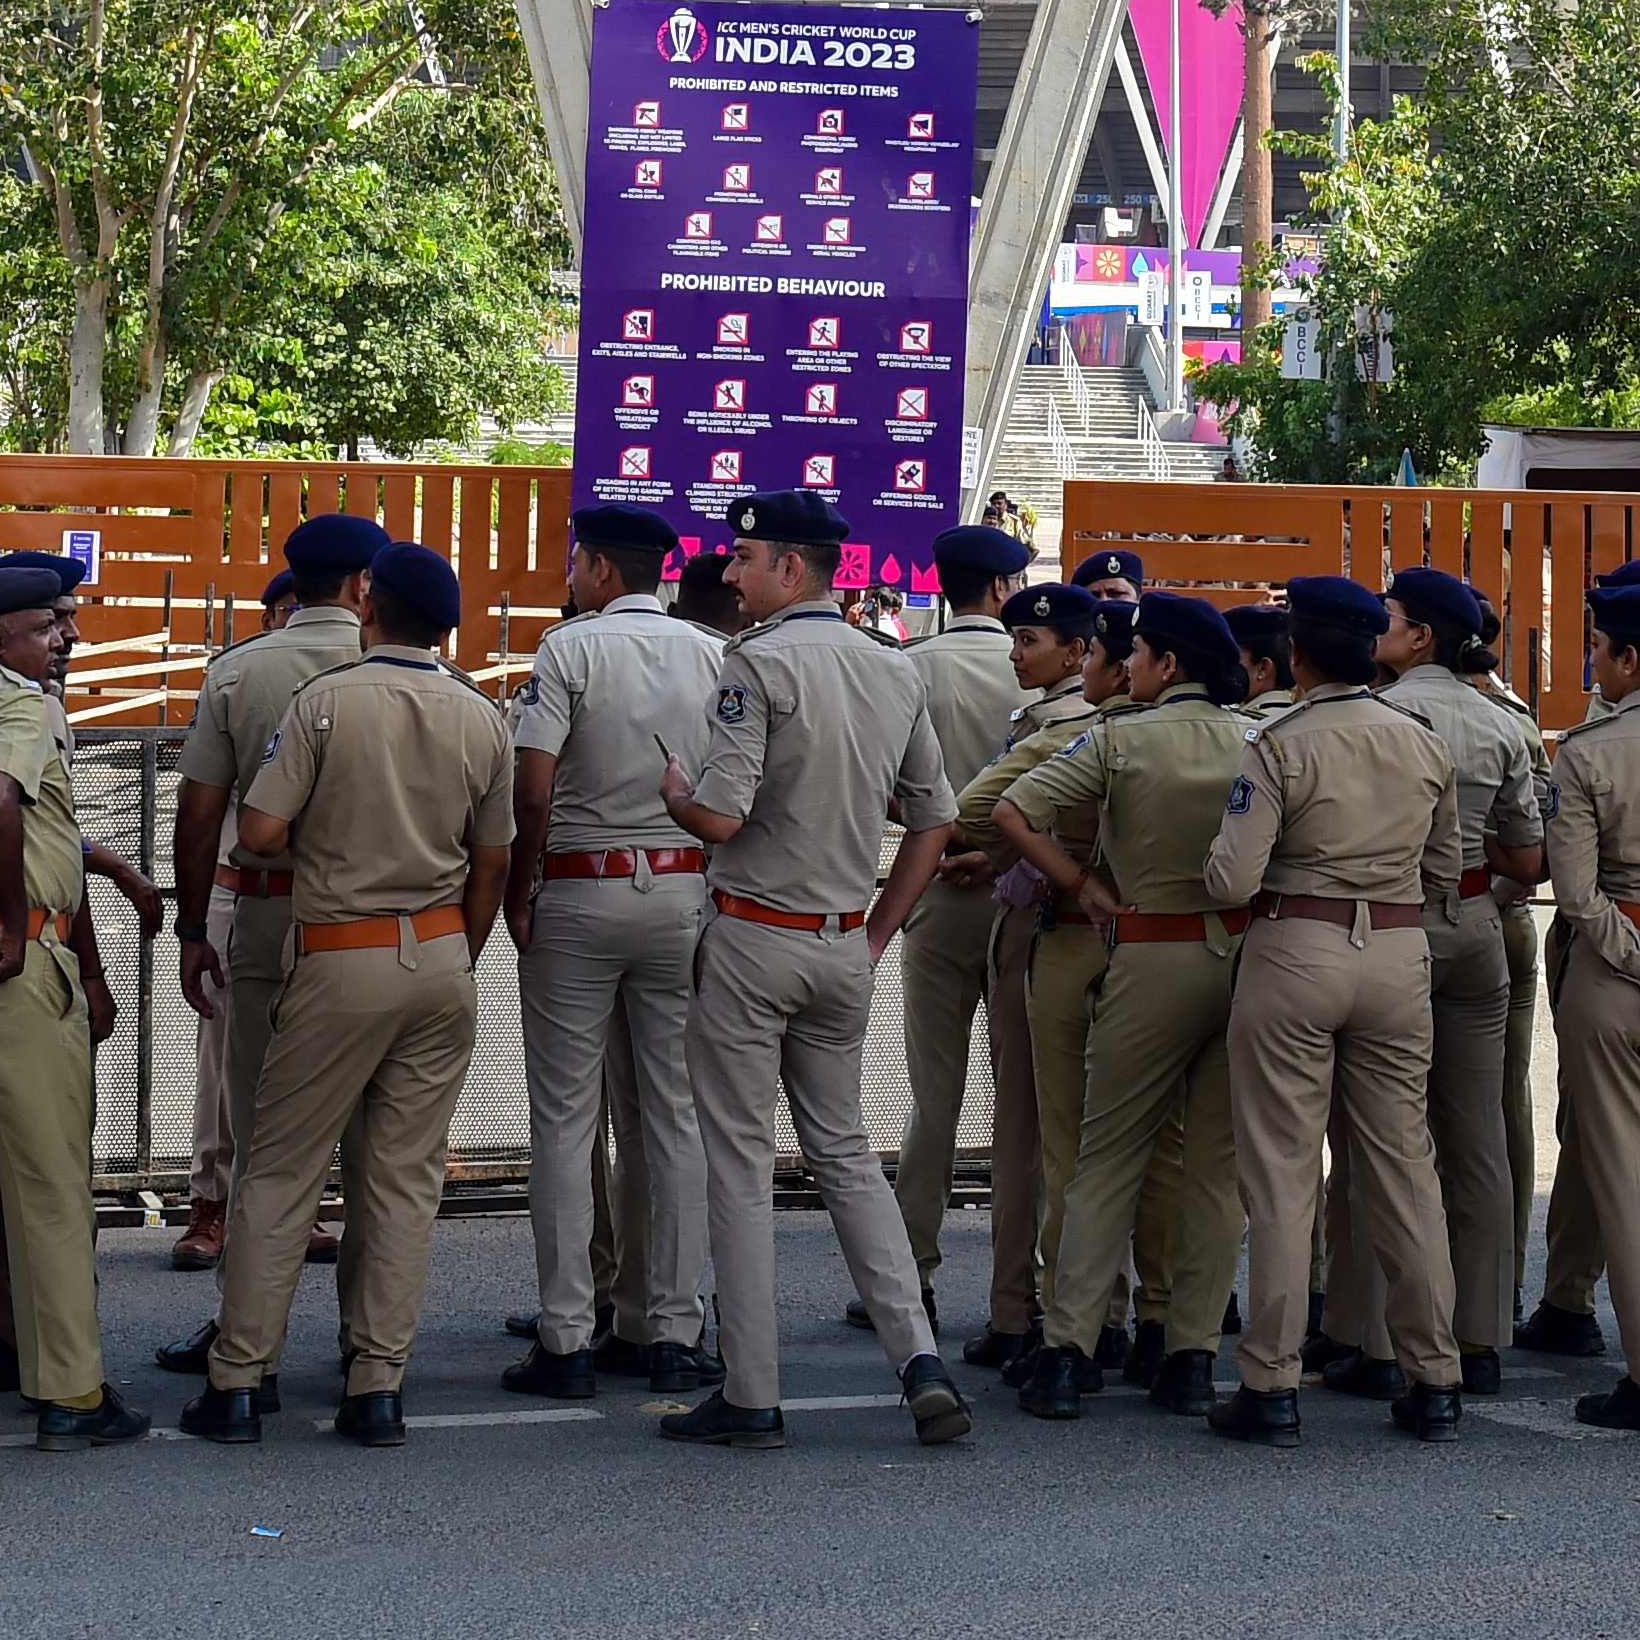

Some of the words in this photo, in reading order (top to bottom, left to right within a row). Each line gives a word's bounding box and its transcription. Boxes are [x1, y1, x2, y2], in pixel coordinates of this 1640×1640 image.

[717, 21, 738, 33] ICC
[740, 23, 779, 35] MEN'S
[782, 24, 836, 37] CRICKET
[840, 27, 887, 39] WORLD
[890, 29, 916, 40] CUP
[715, 36, 816, 66] INDIA
[823, 41, 915, 69] 2023
[670, 77, 746, 91] PROHIBITED
[749, 81, 777, 93] AND
[780, 82, 857, 95] RESTRICTED
[860, 85, 899, 97] ITEMS
[661, 273, 772, 292] PROHIBITED
[777, 278, 885, 297] BEHAVIOUR
[1296, 326, 1307, 375] BCCI
